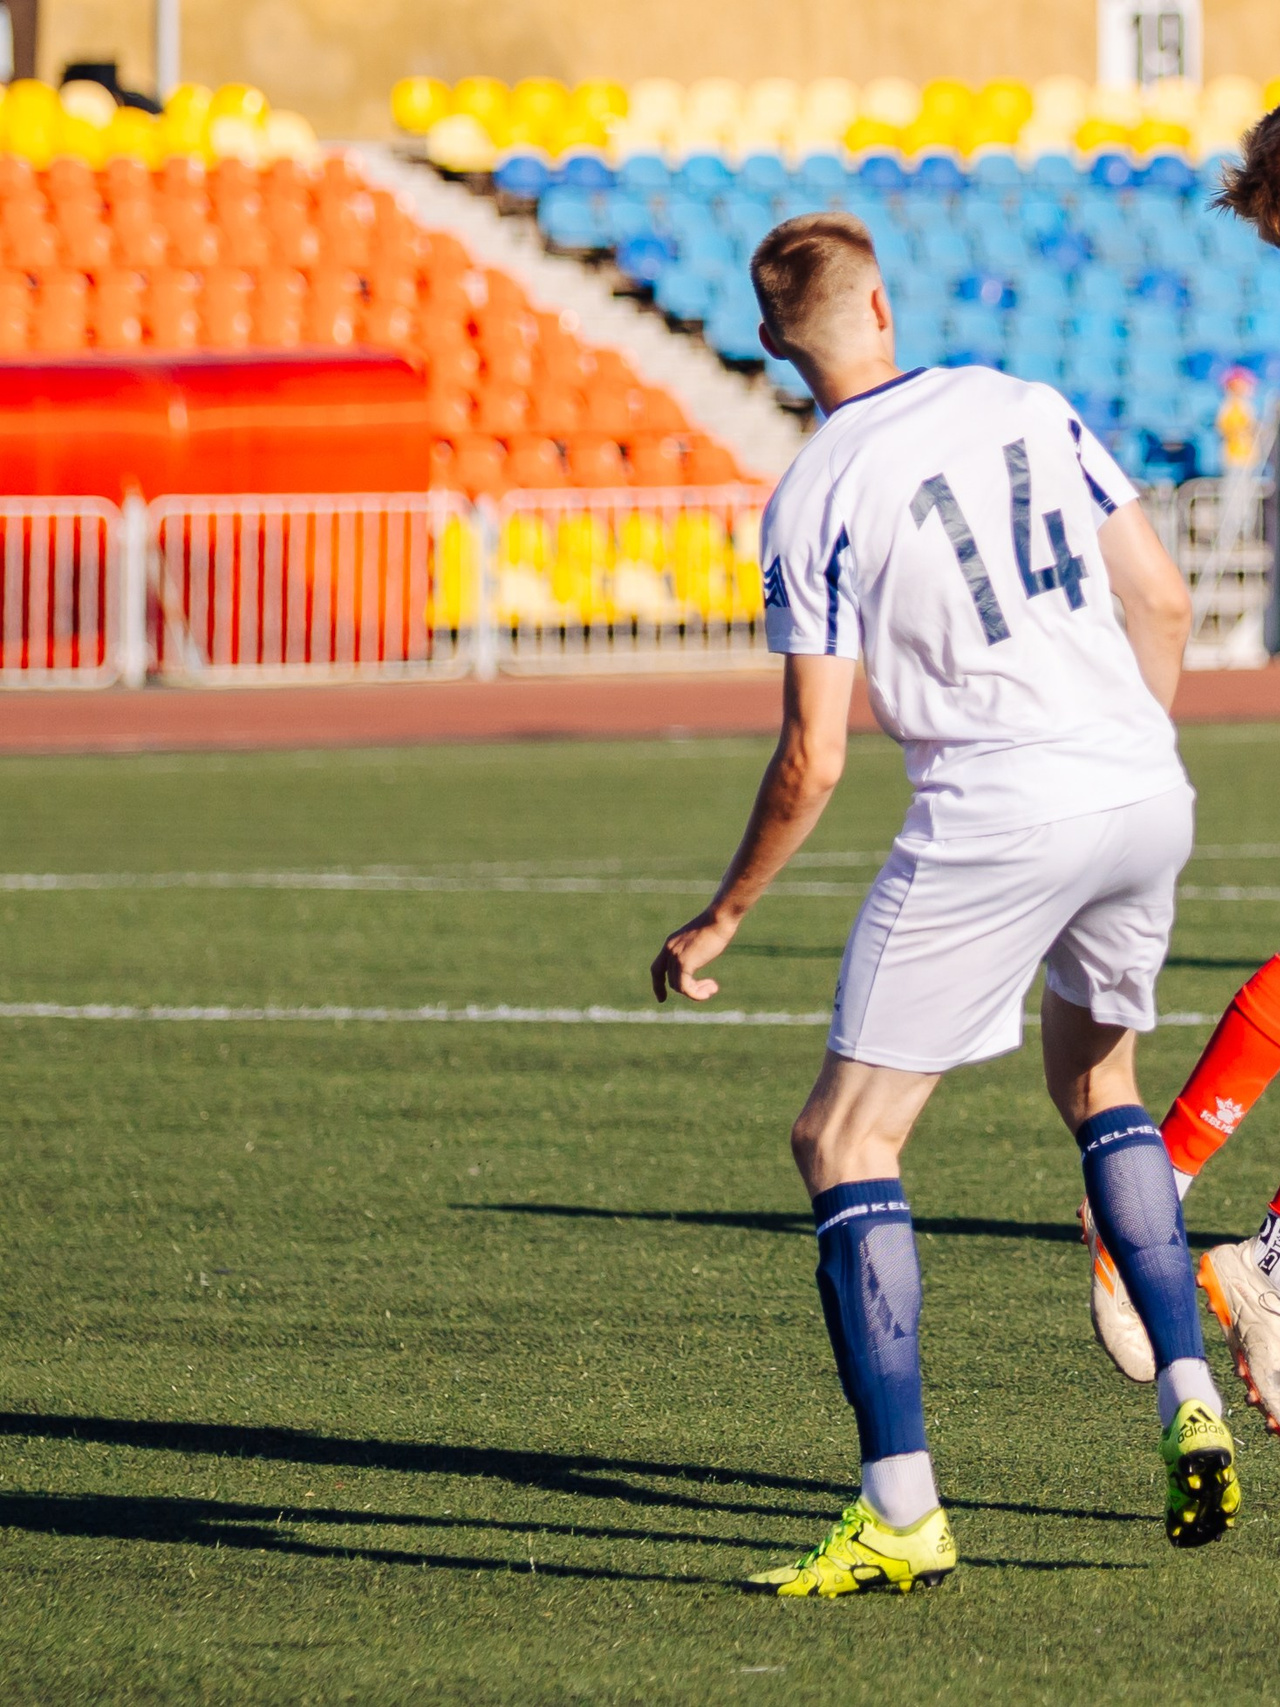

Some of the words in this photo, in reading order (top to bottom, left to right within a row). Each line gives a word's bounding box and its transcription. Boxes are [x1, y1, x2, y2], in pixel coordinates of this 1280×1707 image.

[909, 437, 1088, 647] 14
[1087, 1125, 1155, 1151] KELME
[1177, 1422, 1225, 1444] adidas
